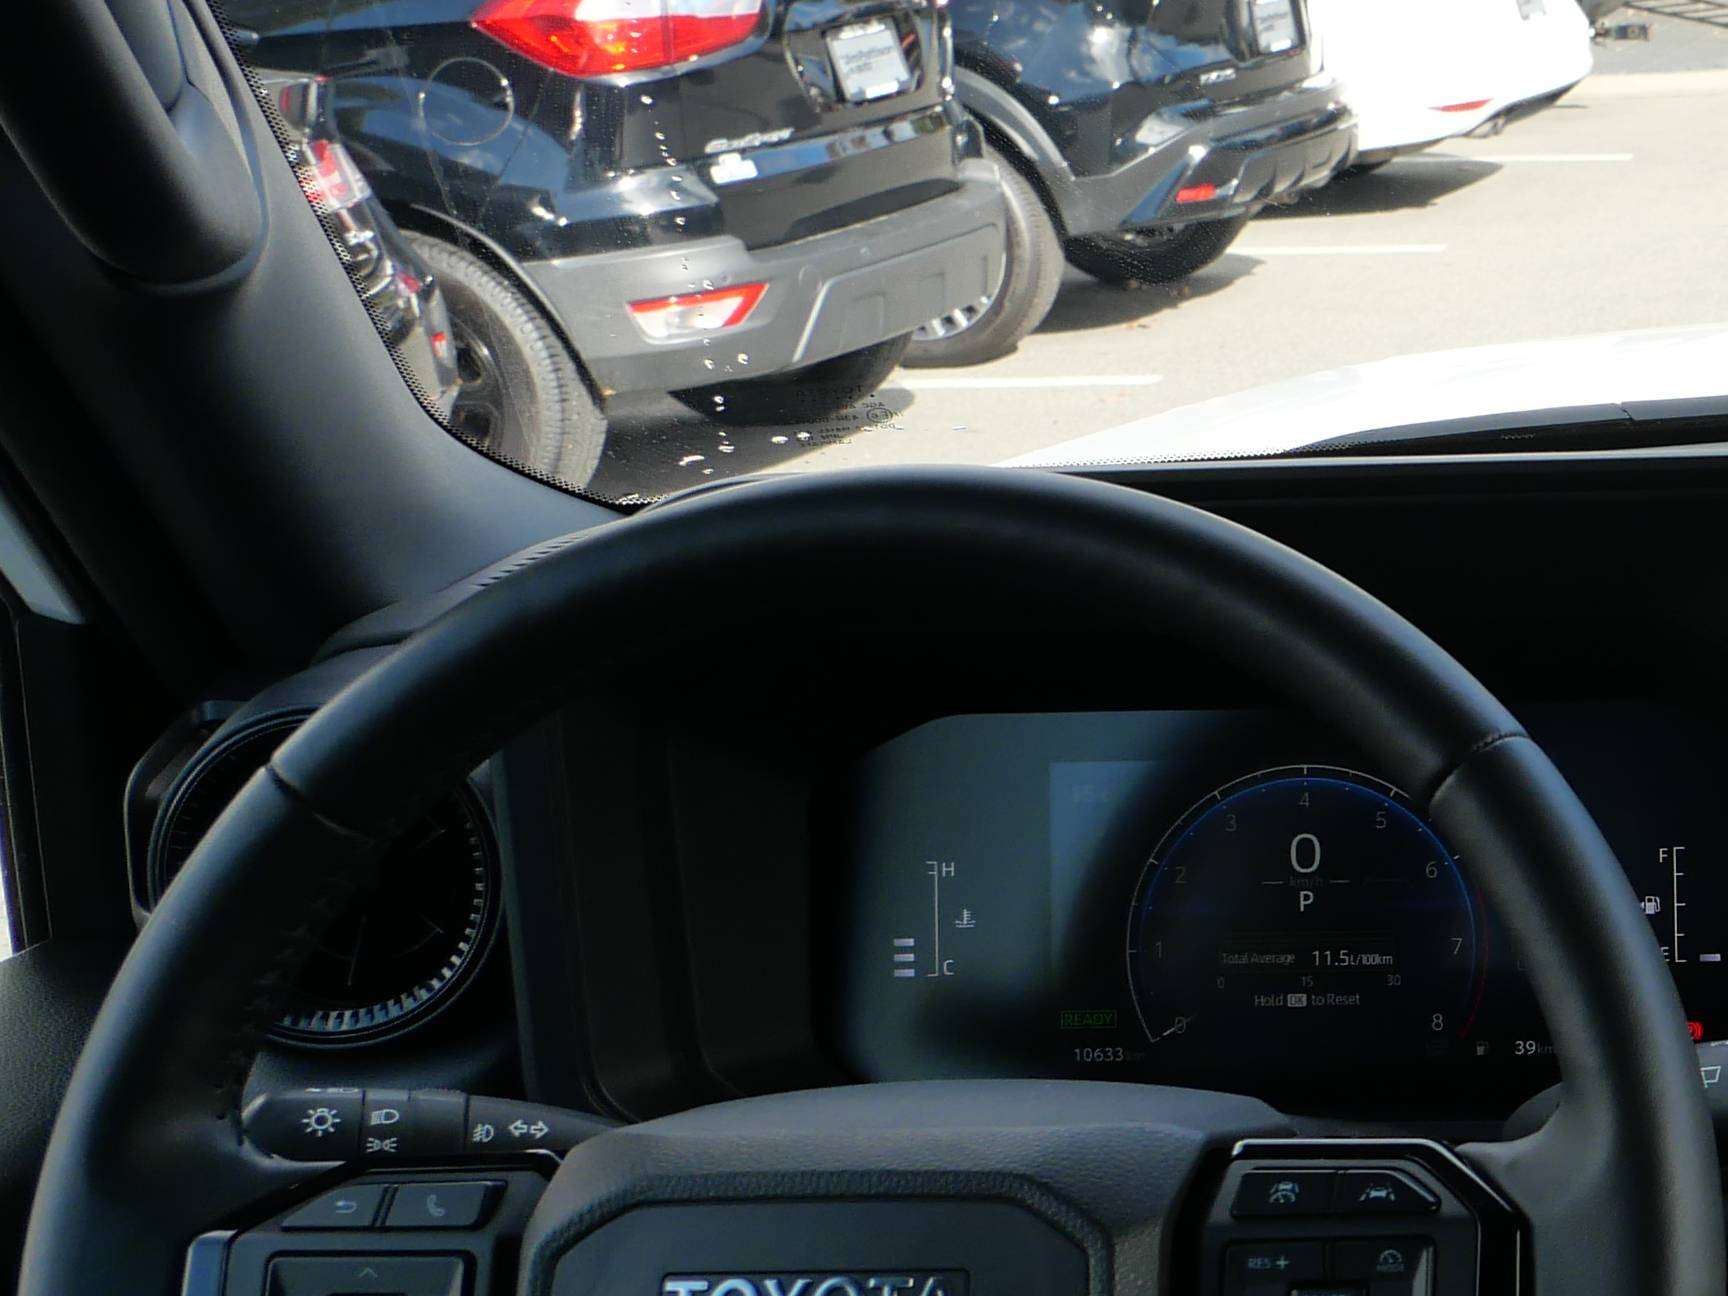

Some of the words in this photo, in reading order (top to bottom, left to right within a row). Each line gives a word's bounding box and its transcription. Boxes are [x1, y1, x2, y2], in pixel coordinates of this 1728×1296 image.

[1299, 795, 1310, 807] 4
[1225, 814, 1237, 832] 3
[1375, 812, 1387, 829] 5
[1290, 833, 1322, 873] 0
[1659, 848, 1668, 863] F
[942, 862, 955, 877] H
[1175, 866, 1187, 884] 2
[1426, 862, 1438, 879] 6
[1299, 891, 1314, 912] P
[1154, 941, 1163, 959] 1
[1451, 937, 1463, 955] 7
[1221, 952, 1249, 965] Total
[1250, 952, 1295, 967] Average
[943, 961, 955, 976] C
[1217, 975, 1225, 989] 0
[1300, 975, 1313, 988] 15
[1386, 973, 1401, 987] 30
[1254, 993, 1284, 1007] Hold
[1311, 994, 1324, 1006] to
[1326, 992, 1360, 1006] Reset
[1063, 1012, 1115, 1027] READY
[1432, 1013, 1444, 1031] 8
[1073, 1046, 1125, 1062] 10633
[1514, 1040, 1536, 1055] 39
